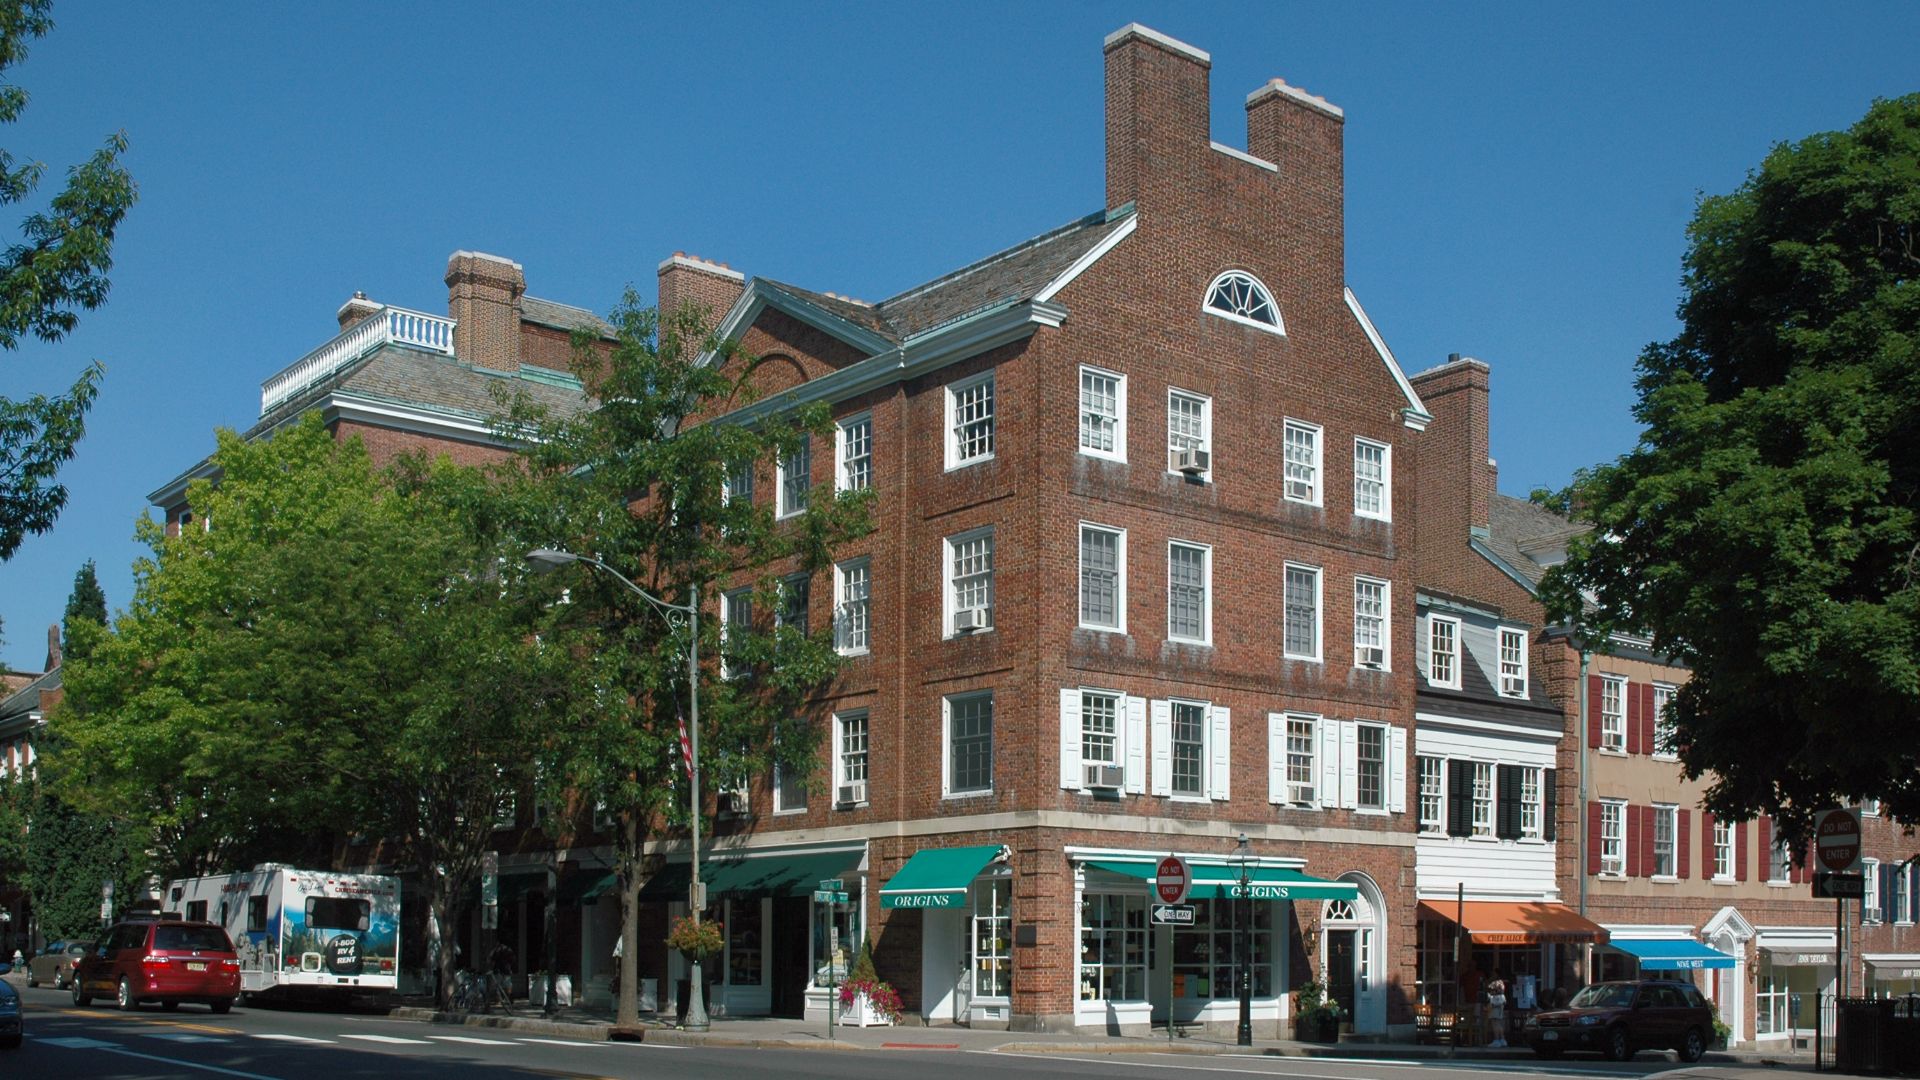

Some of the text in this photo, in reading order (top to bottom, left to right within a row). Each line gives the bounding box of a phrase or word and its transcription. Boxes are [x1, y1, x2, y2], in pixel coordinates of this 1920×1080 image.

[1824, 822, 1851, 833] DO NOT
[1826, 850, 1850, 860] ENTER
[1161, 866, 1180, 874] DO NOT
[1832, 881, 1845, 890] ONE
[1162, 887, 1178, 895] ENTER
[1231, 886, 1288, 898] OIGINS
[894, 895, 949, 907] ORIGINS
[1164, 910, 1190, 919] ONE WAY
[335, 939, 356, 947] 1-800
[348, 946, 355, 956] 4
[337, 956, 356, 964] RENT
[1676, 960, 1704, 968] NINE WEST
